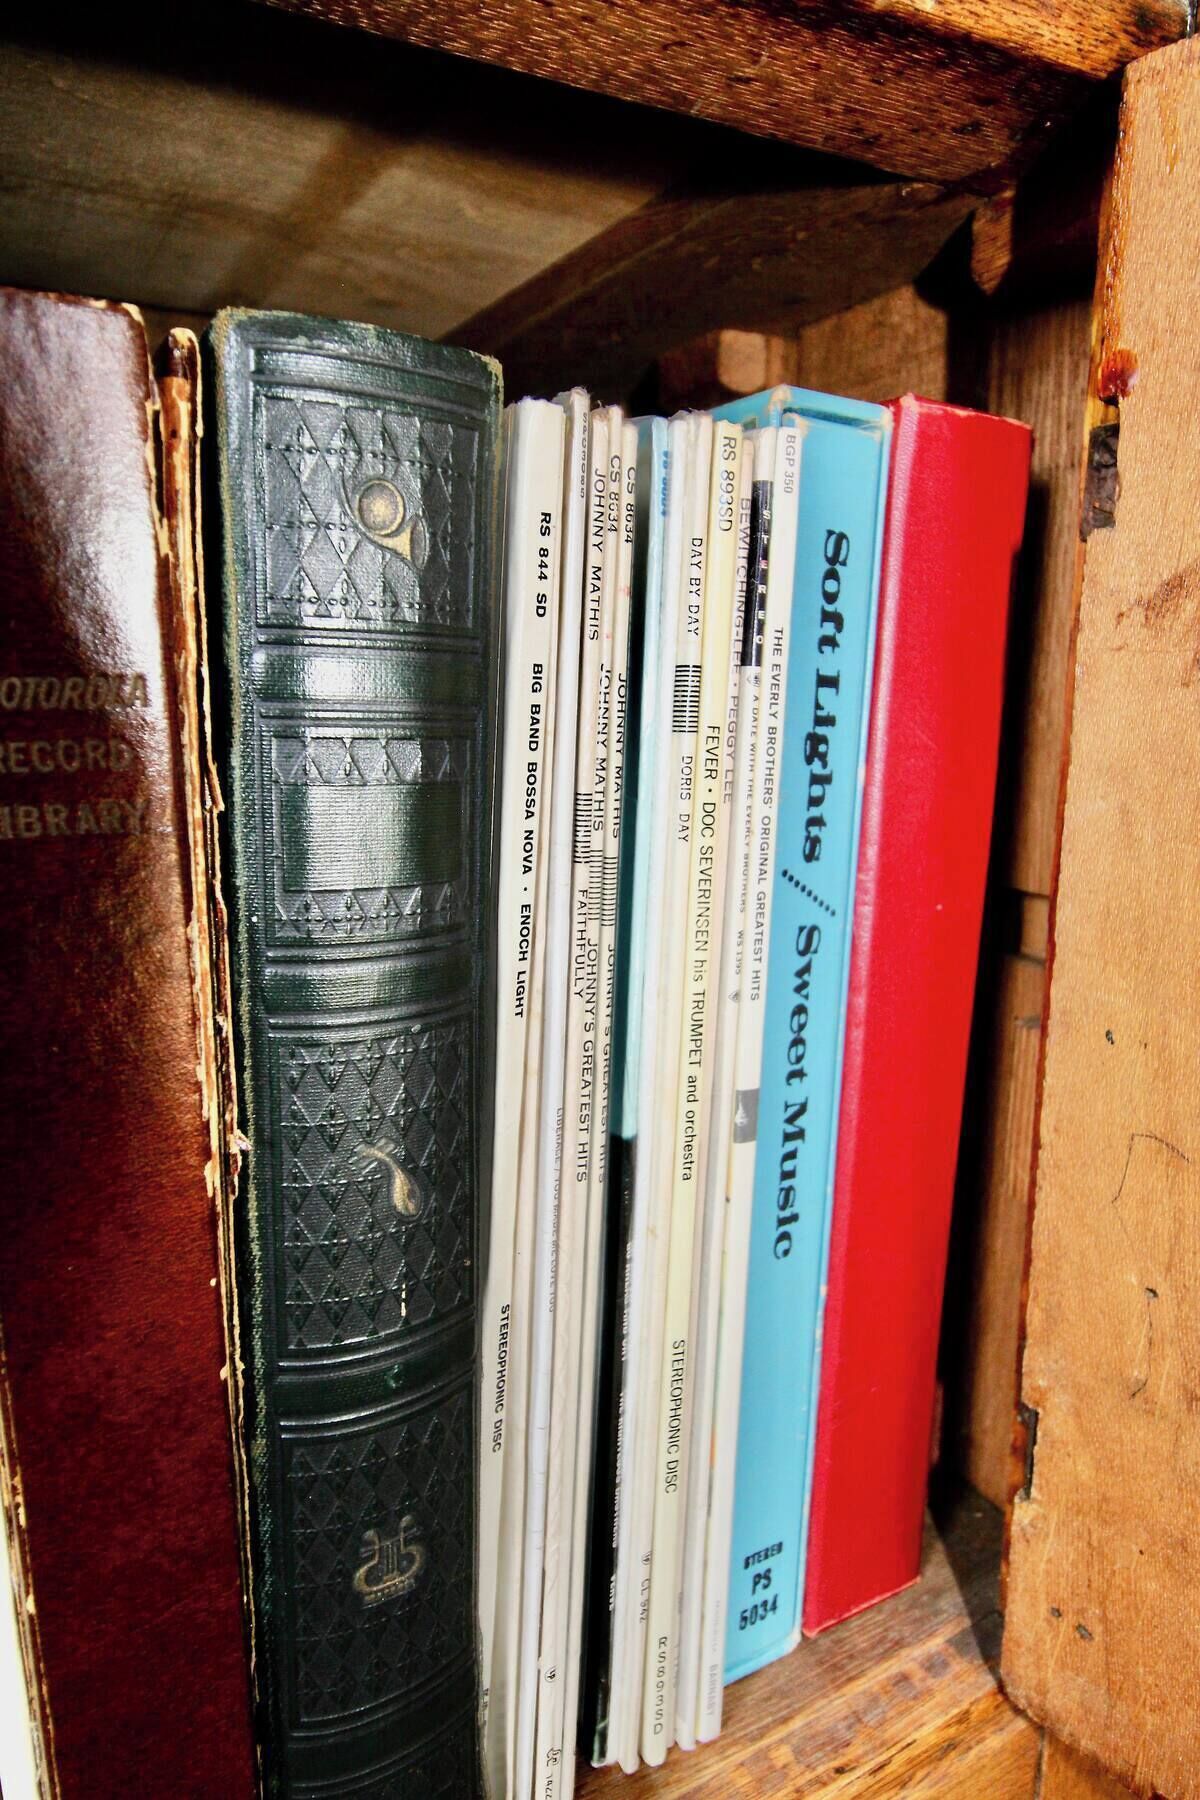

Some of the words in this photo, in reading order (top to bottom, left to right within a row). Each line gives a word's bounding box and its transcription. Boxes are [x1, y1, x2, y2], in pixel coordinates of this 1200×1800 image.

[609, 455, 621, 483] CS
[722, 436, 737, 461] RS
[784, 434, 797, 467] BGP
[783, 470, 794, 494] 350
[539, 512, 552, 537] RS
[592, 468, 606, 552] JOHNNY
[537, 547, 548, 581] 844
[690, 537, 703, 569] DAY
[535, 592, 547, 618] SD
[588, 565, 602, 640] MATHIS
[689, 577, 700, 597] BY
[817, 528, 851, 655] Soft
[687, 604, 700, 636] DAY
[772, 627, 784, 656] THE
[531, 663, 543, 693] BIG
[753, 694, 760, 702] A
[768, 663, 782, 719] EVERLY
[528, 703, 541, 752] BAND
[596, 663, 612, 749] JOHNNY
[615, 673, 628, 755] JOHNNY
[725, 696, 739, 760] PEGGY
[750, 707, 759, 739] DATE
[704, 725, 720, 780] FEVER
[762, 726, 778, 809] BROTHERS'
[802, 668, 841, 864] Lights
[524, 761, 538, 820] BOSSA
[593, 757, 607, 831] MATHIS
[680, 755, 693, 801] DORIS
[723, 769, 734, 804] LEE
[746, 778, 754, 801] THE
[678, 813, 690, 843] DAY
[700, 802, 716, 838] DOC
[522, 829, 534, 875] NOVA
[757, 815, 772, 885] ORIGINAL
[695, 845, 713, 952] SEVERINSEN
[518, 904, 531, 962] ENOCH
[573, 889, 588, 998] FAITHFULLY
[752, 891, 766, 963] GREATEST
[584, 938, 598, 1032] JOHNNY'S
[693, 959, 707, 982] his
[750, 970, 761, 1001] HITS
[514, 970, 527, 1018] LIGHT
[784, 924, 822, 1087] Sweet
[688, 989, 705, 1068] TRUMPET
[578, 1040, 594, 1134] GREATEST
[686, 1075, 699, 1103] and
[576, 1142, 589, 1183] HITS
[681, 1110, 698, 1181] orchestra
[773, 1097, 809, 1260] Music
[494, 1304, 511, 1414] STEREOPHONIC
[666, 1339, 686, 1455] STEREOPHONIC
[492, 1419, 503, 1453] DISC
[664, 1460, 679, 1494] DISC
[751, 1567, 773, 1596] PS
[738, 1593, 779, 1631] 5034
